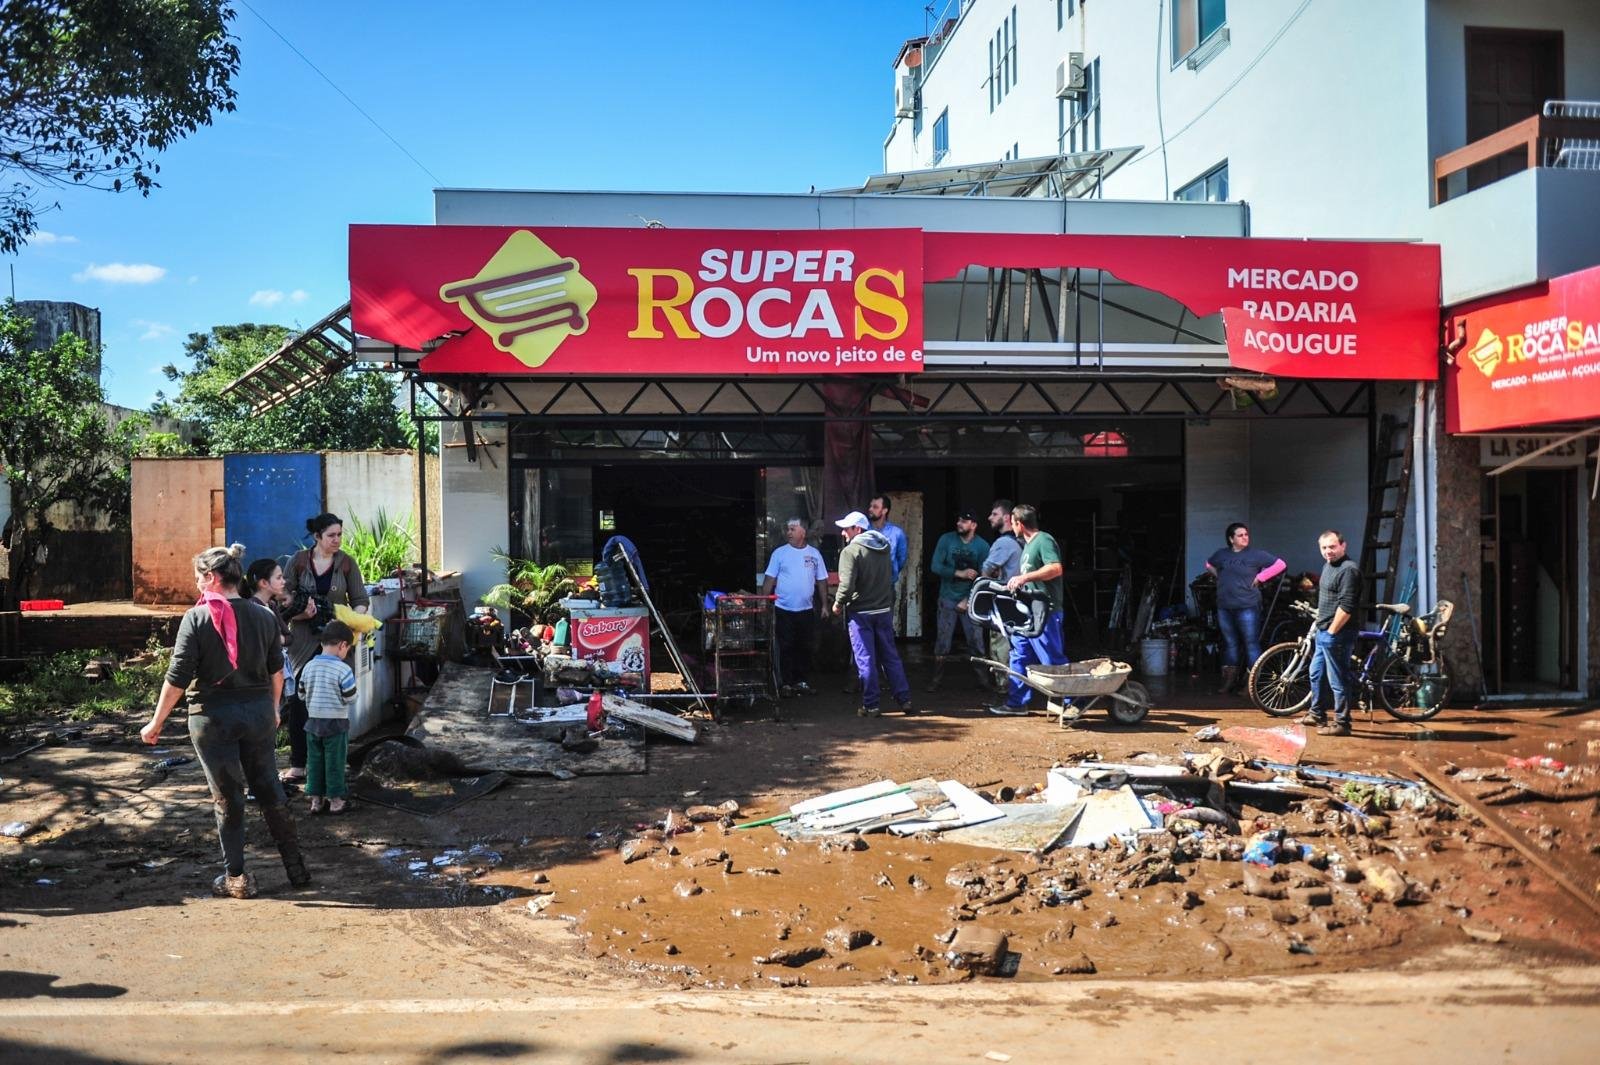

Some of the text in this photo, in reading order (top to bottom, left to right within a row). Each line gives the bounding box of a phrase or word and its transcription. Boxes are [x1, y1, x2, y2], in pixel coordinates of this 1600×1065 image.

[698, 248, 855, 283] SUPER
[1227, 268, 1359, 292] MERCADO
[1524, 316, 1568, 338] SUPER
[1243, 328, 1357, 356] AÇOUGUE
[746, 346, 781, 363] Um
[786, 349, 830, 362] novo
[835, 346, 877, 367] jeito
[882, 346, 906, 361] de
[1491, 375, 1528, 390] MERCADO
[1531, 368, 1567, 383] PADARIA
[1490, 438, 1511, 457] LA
[583, 619, 627, 637] Sabory
